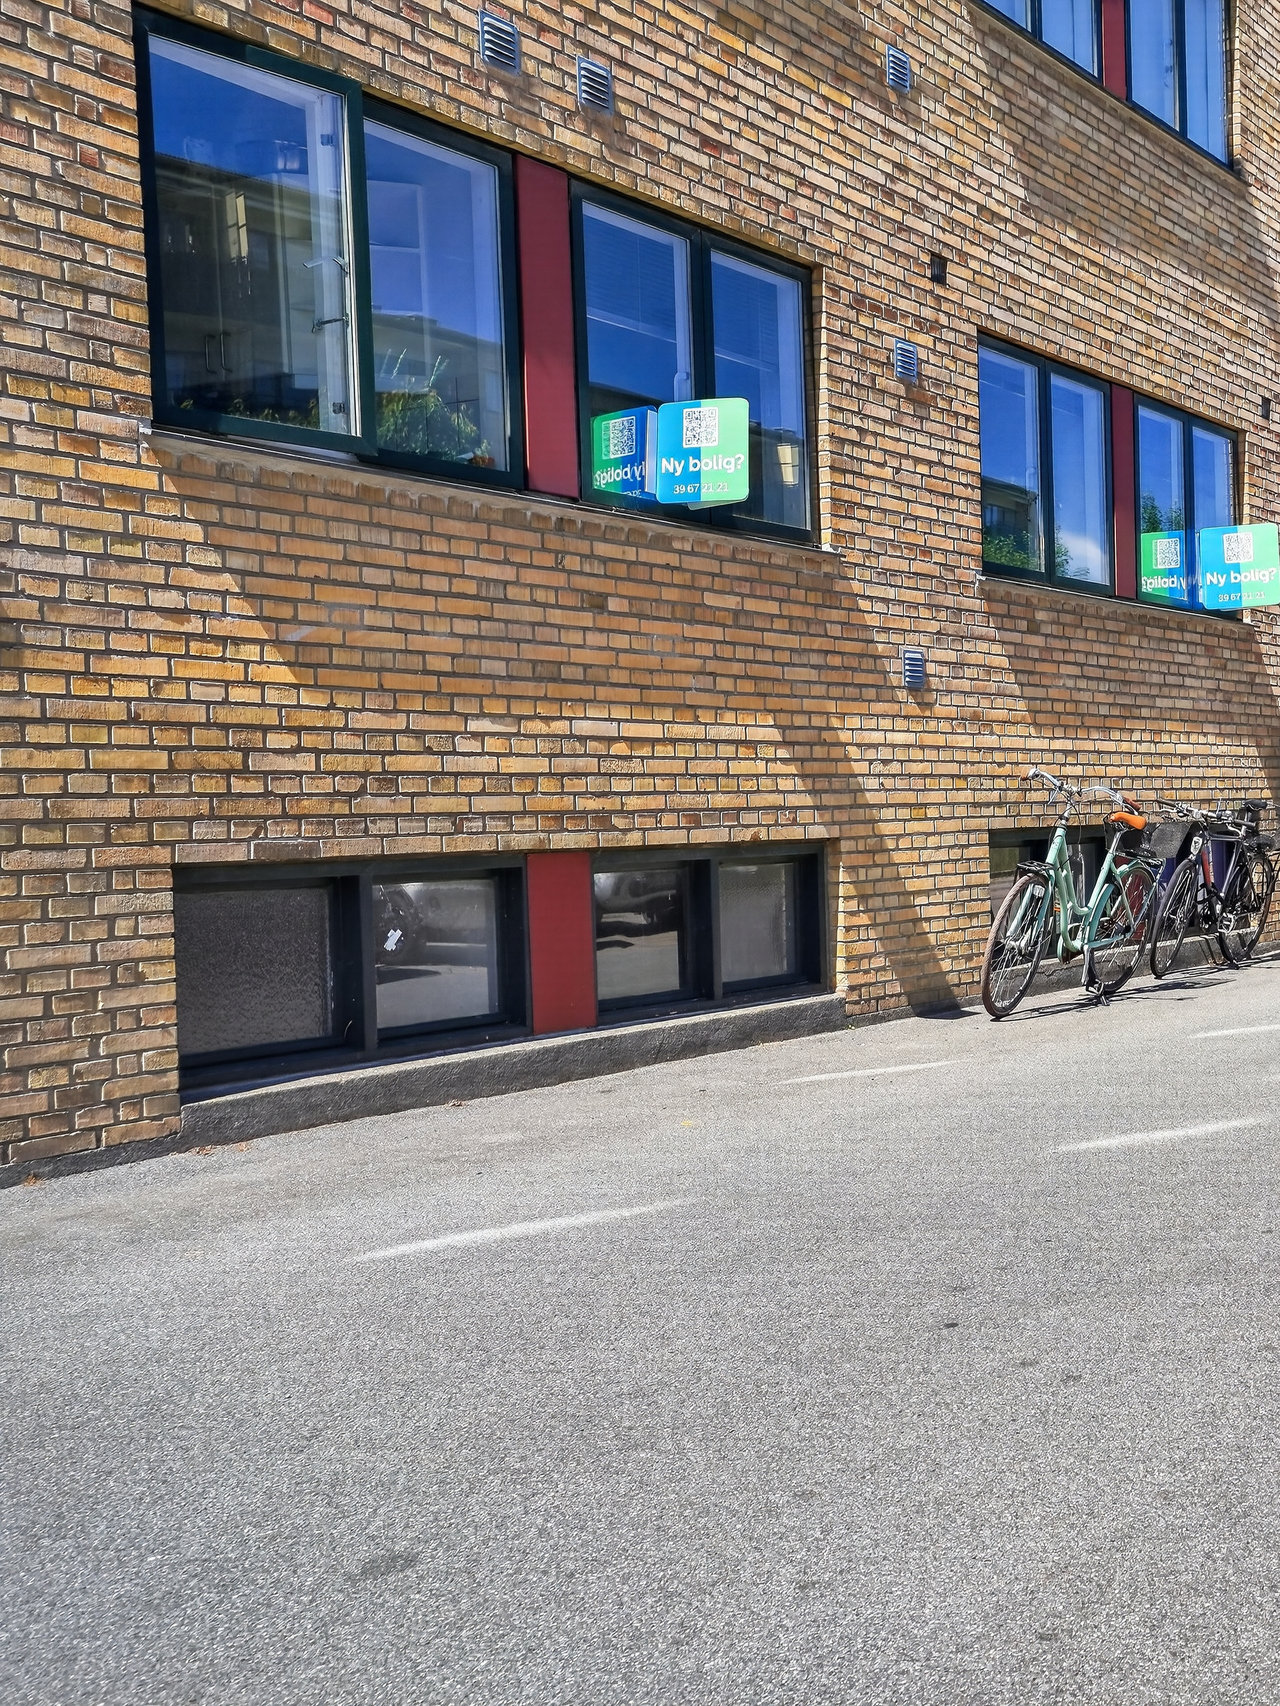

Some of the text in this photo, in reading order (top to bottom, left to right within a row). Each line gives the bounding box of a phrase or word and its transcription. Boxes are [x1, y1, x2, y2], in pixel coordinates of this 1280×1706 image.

[661, 453, 745, 476] Ny bolig?
[673, 481, 729, 495] 39 67 21 21
[1206, 567, 1277, 587] Ny bolig?
